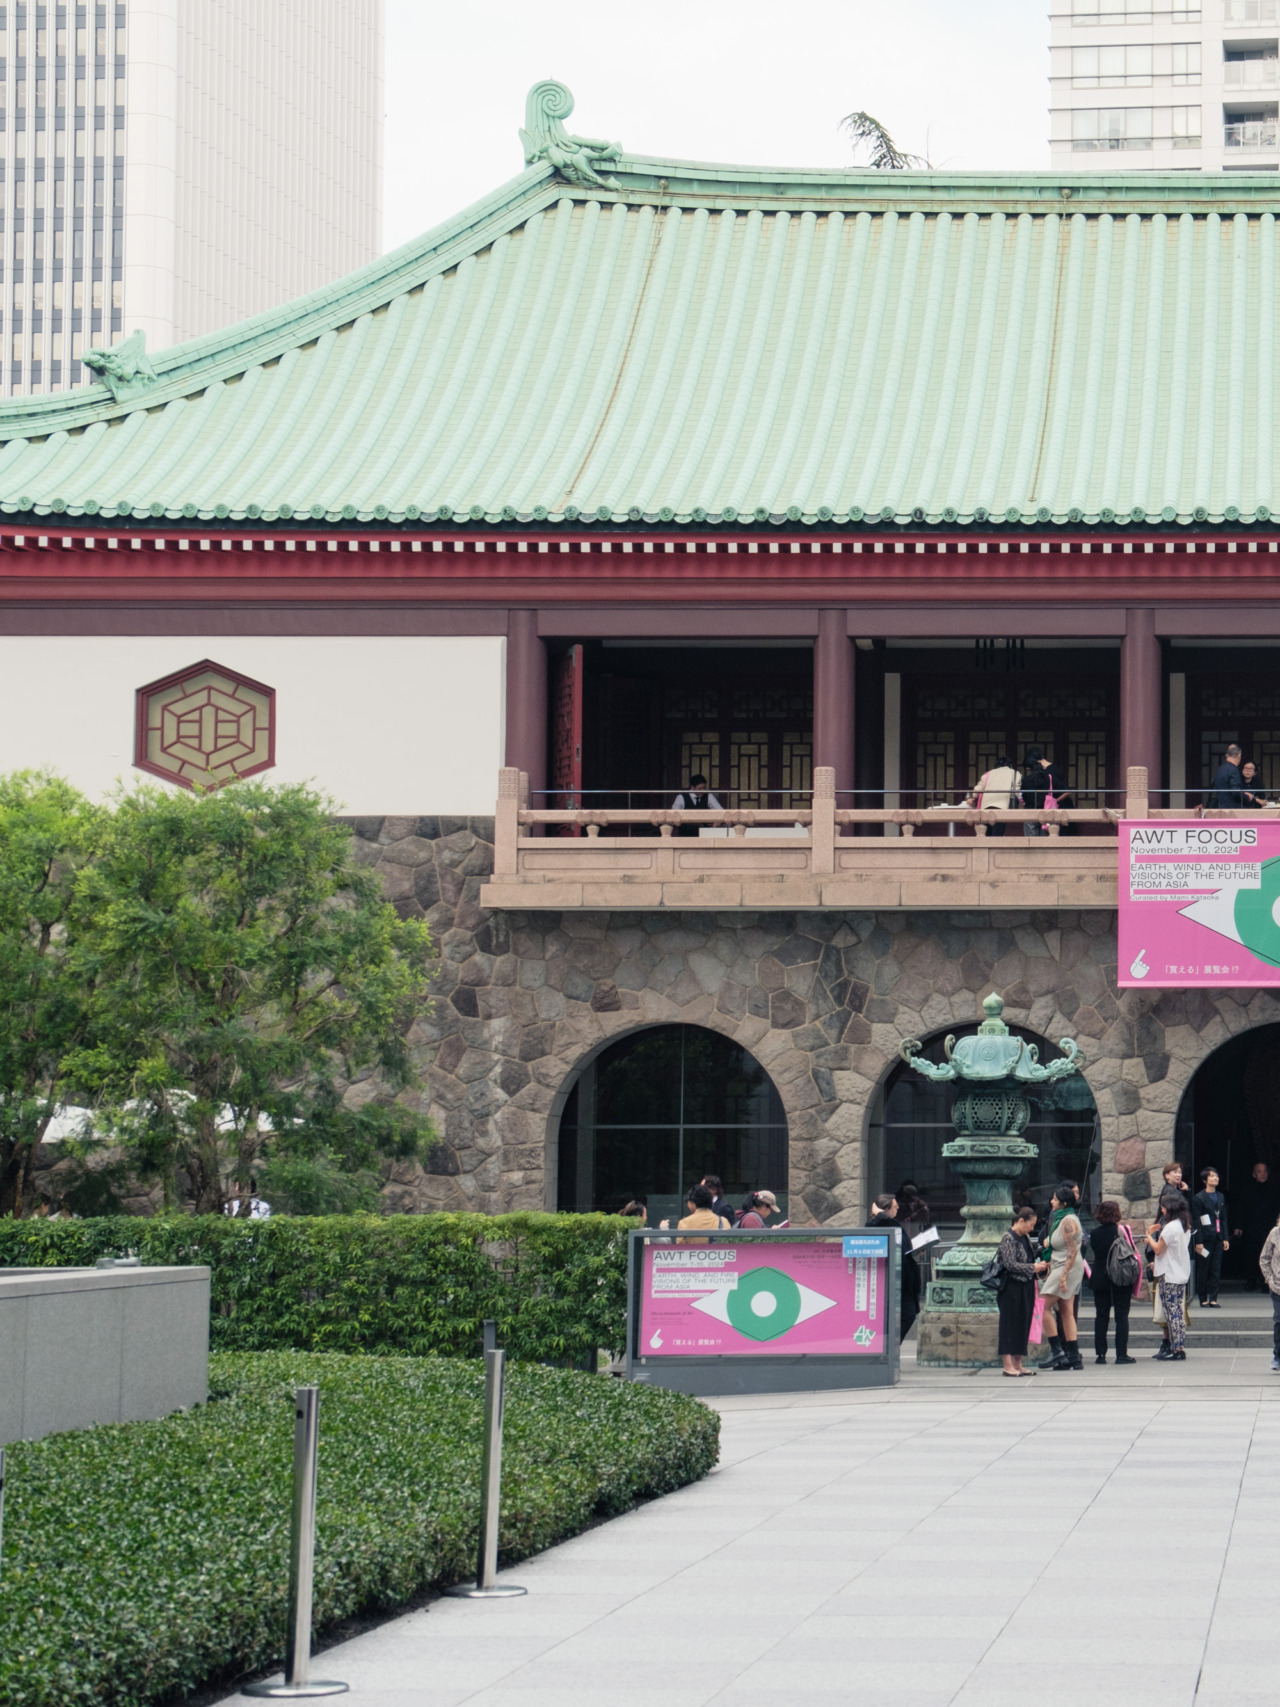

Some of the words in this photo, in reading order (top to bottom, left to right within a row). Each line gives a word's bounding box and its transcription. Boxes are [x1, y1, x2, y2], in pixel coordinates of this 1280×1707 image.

[1131, 829, 1178, 844] AWT
[1185, 829, 1257, 844] FOCUS
[1130, 846, 1184, 854] November
[1214, 846, 1239, 854] 2024
[1130, 863, 1170, 872] EARTH,
[1173, 863, 1205, 872] WIND,
[1208, 863, 1231, 871] AND
[1234, 863, 1260, 871] FIRE:
[1130, 872, 1173, 880] VISIONS
[1176, 872, 1191, 880] OF
[1194, 872, 1215, 880] THE
[1218, 872, 1260, 880] FUTURE
[1130, 881, 1162, 889] FROM
[1165, 881, 1189, 889] ASIA
[654, 1251, 685, 1260] AWT
[689, 1251, 735, 1260] FOCUS
